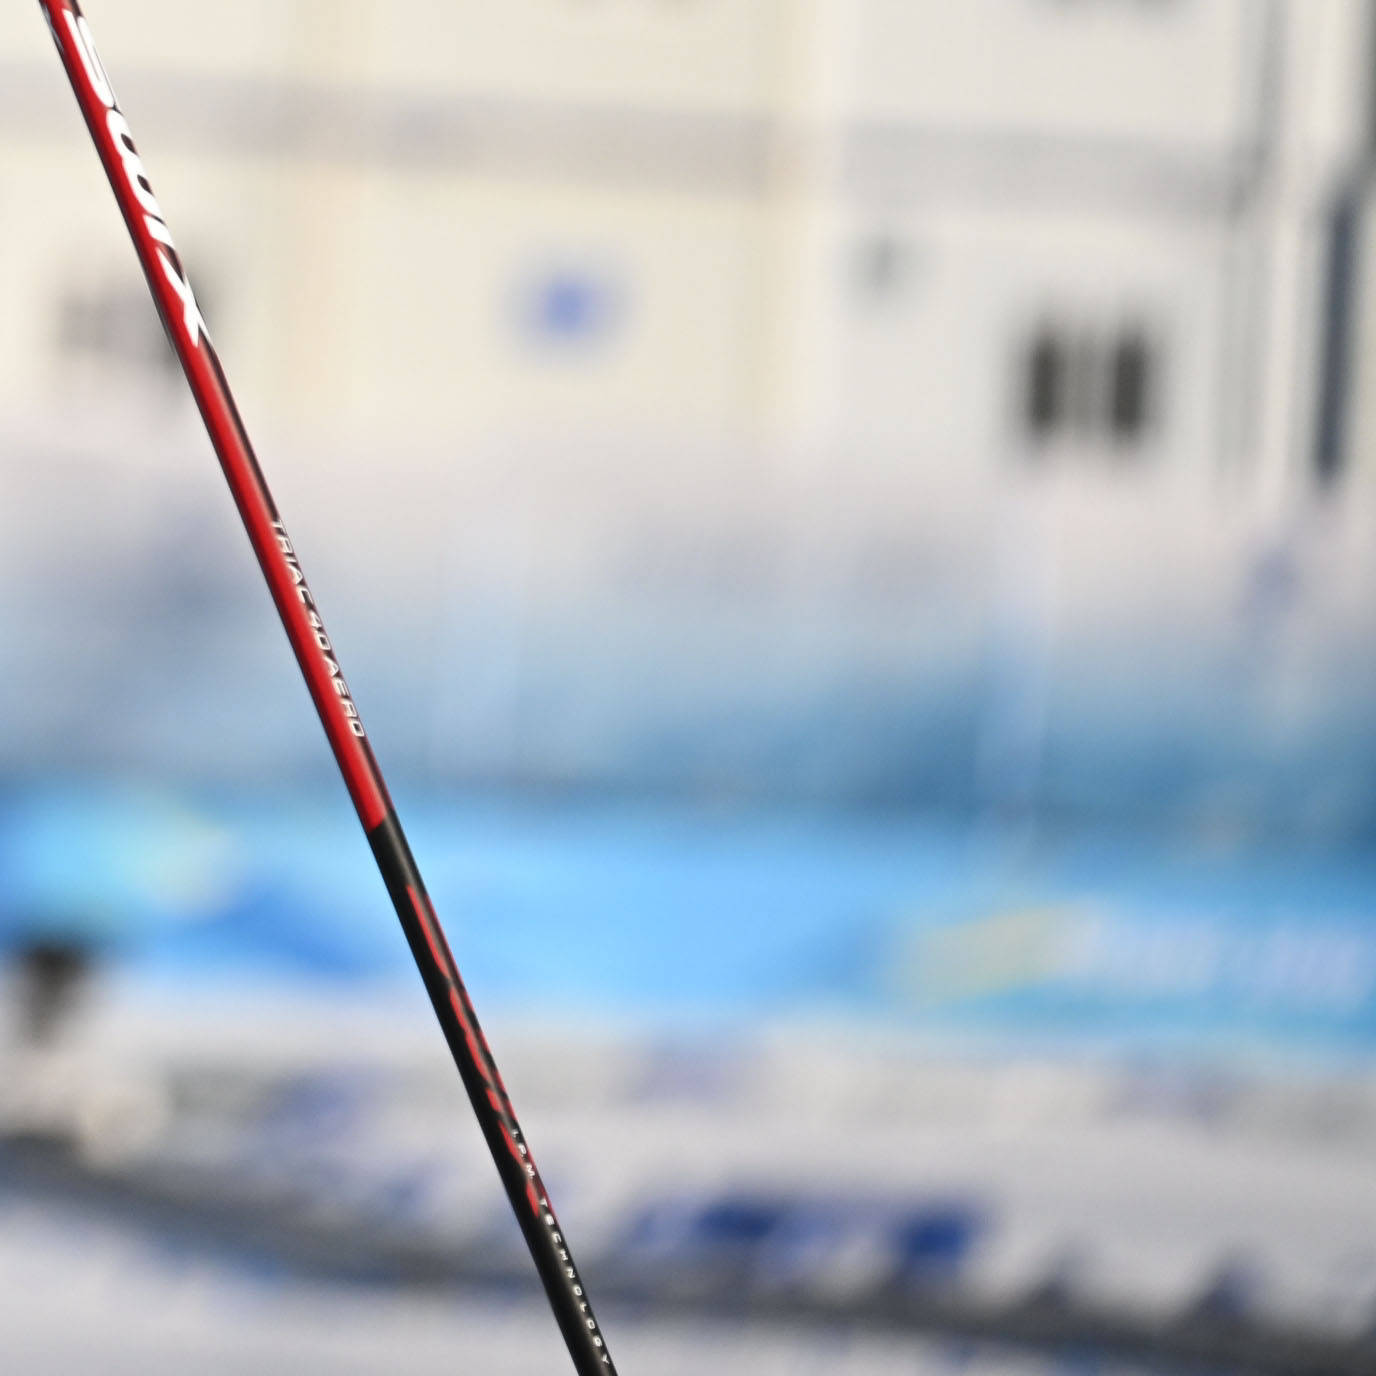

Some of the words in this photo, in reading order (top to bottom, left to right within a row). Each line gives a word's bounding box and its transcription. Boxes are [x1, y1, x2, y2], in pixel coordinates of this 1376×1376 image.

[61, 7, 213, 348] SWIX
[272, 519, 315, 606] TRIAC
[324, 654, 366, 738] AERO
[539, 1197, 611, 1365] TECHNOLOGY
